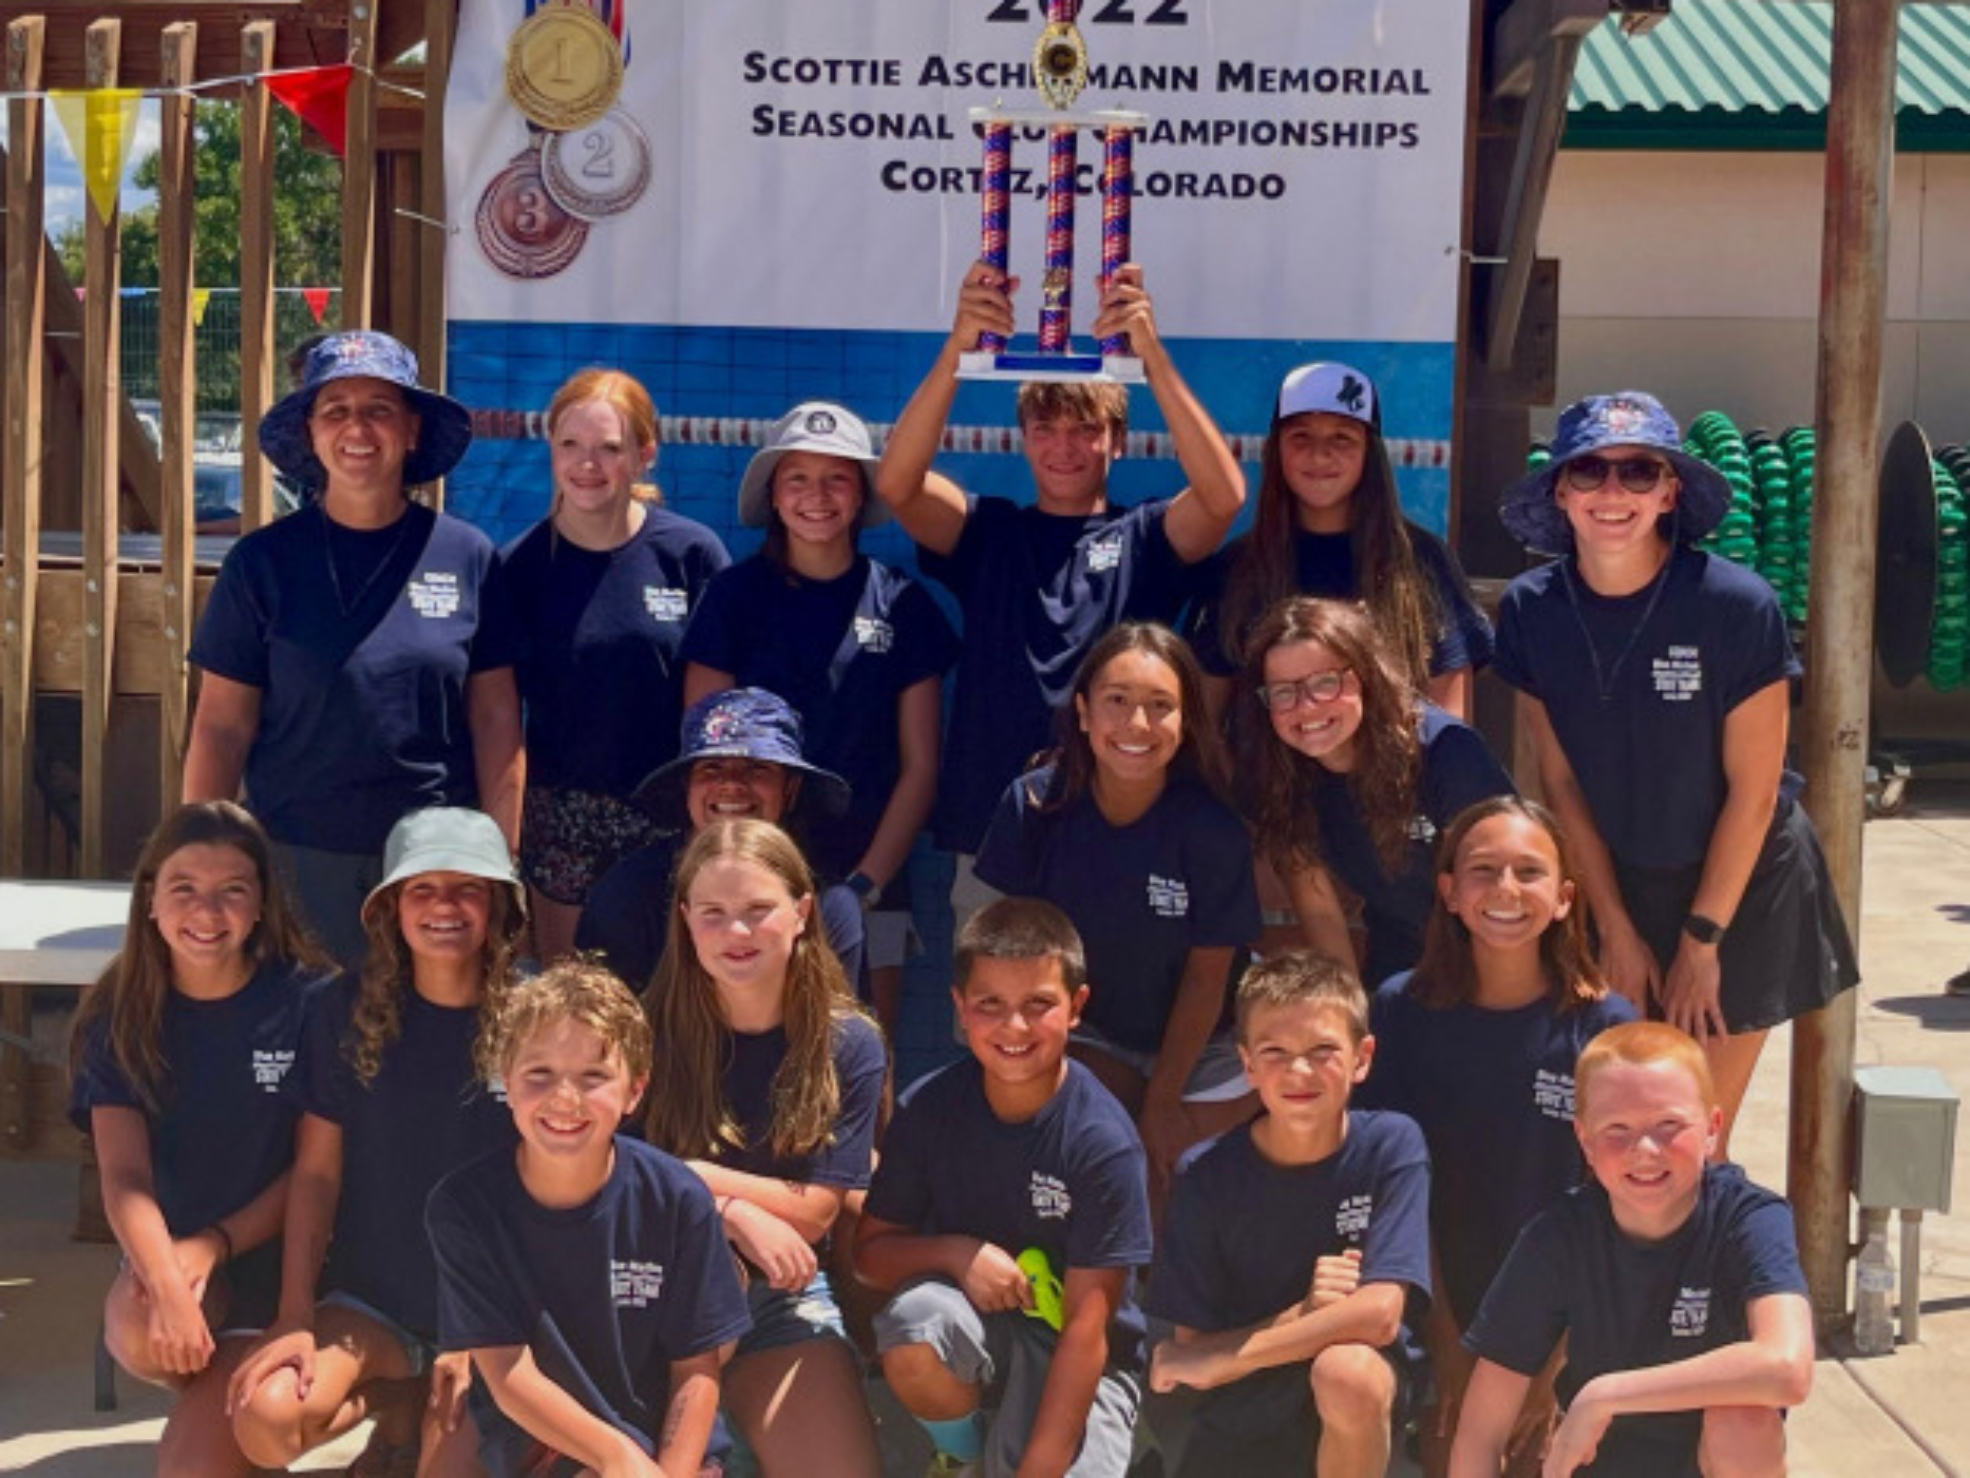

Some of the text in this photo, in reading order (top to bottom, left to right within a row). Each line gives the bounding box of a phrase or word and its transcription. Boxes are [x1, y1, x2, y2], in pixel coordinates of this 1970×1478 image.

[550, 38, 573, 84] 1
[743, 50, 1432, 96] SCOTTIE ASCHMANN MEMORIAL
[752, 104, 955, 140] SEASONAL
[581, 131, 614, 179] 2
[880, 160, 1050, 200] CORTZ,
[514, 190, 545, 235] 3
